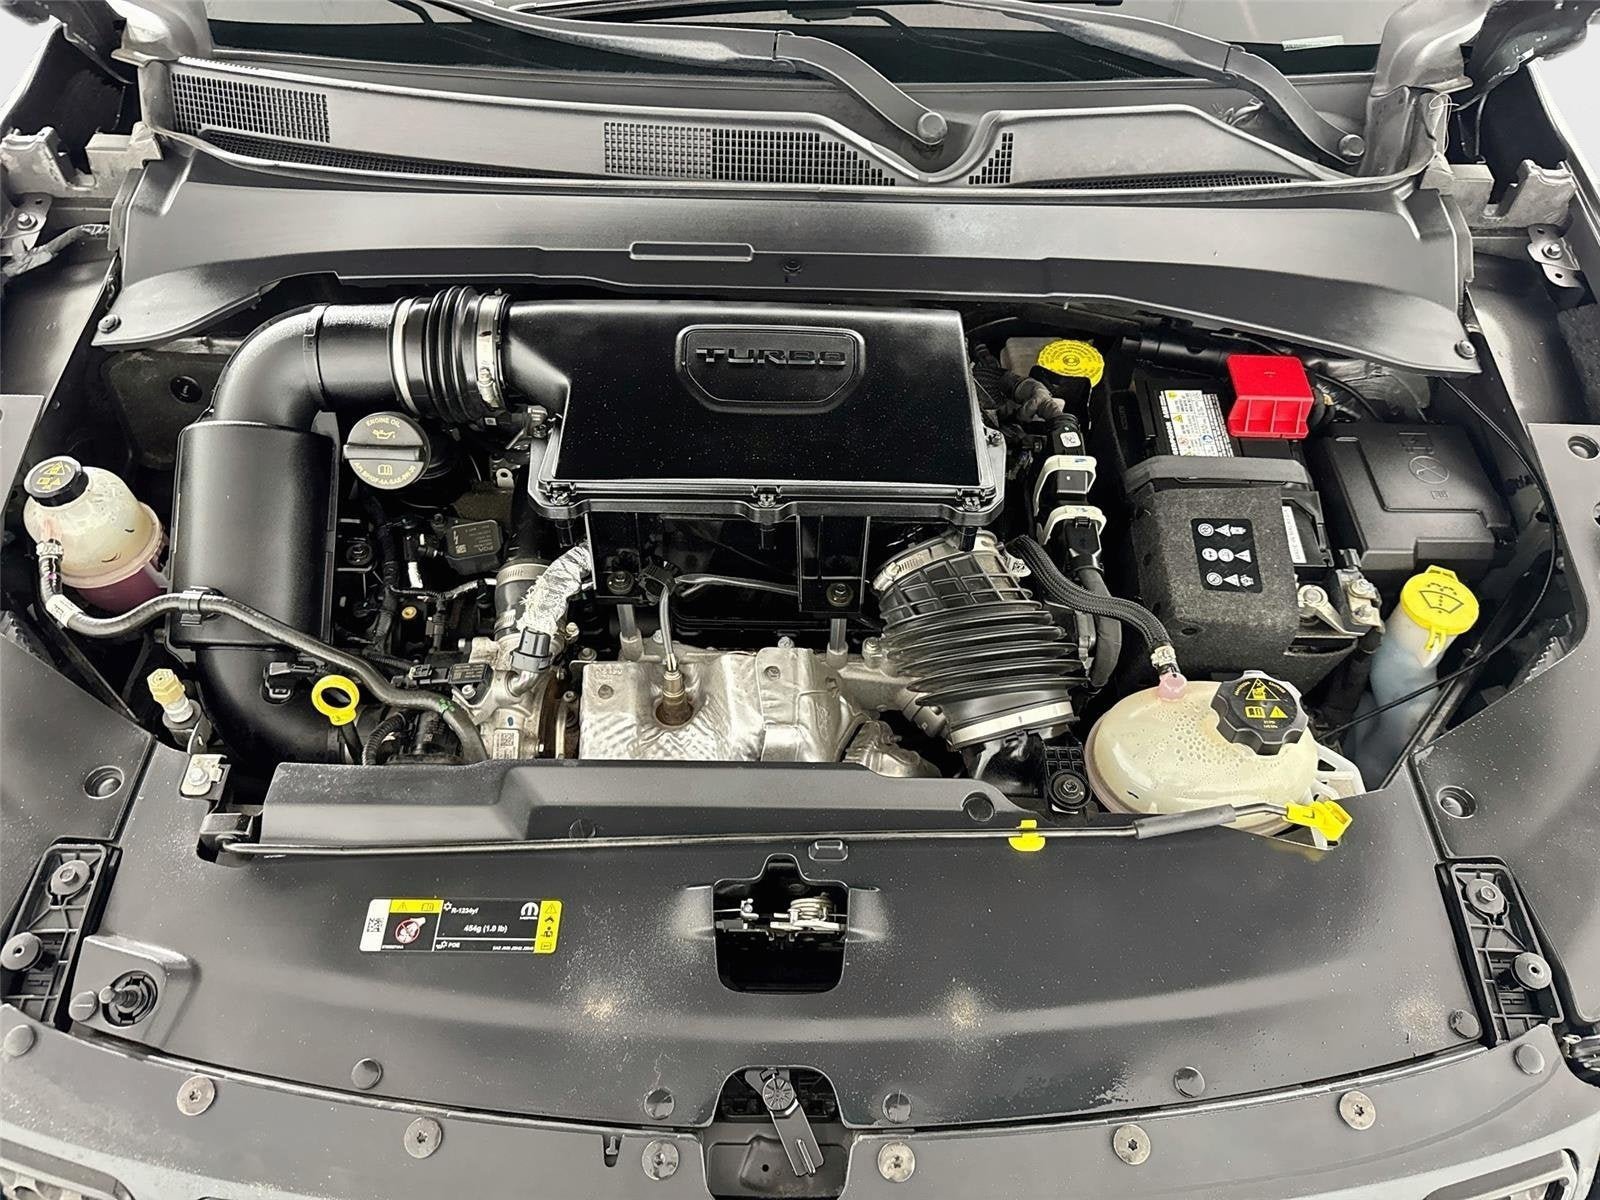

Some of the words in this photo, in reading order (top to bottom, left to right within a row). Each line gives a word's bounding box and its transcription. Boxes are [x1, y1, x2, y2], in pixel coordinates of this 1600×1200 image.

[695, 348, 846, 366] TURBO
[366, 417, 390, 427] ENGINE
[390, 419, 401, 428] OIL
[463, 925, 482, 933] 454g
[497, 925, 508, 933] lb)
